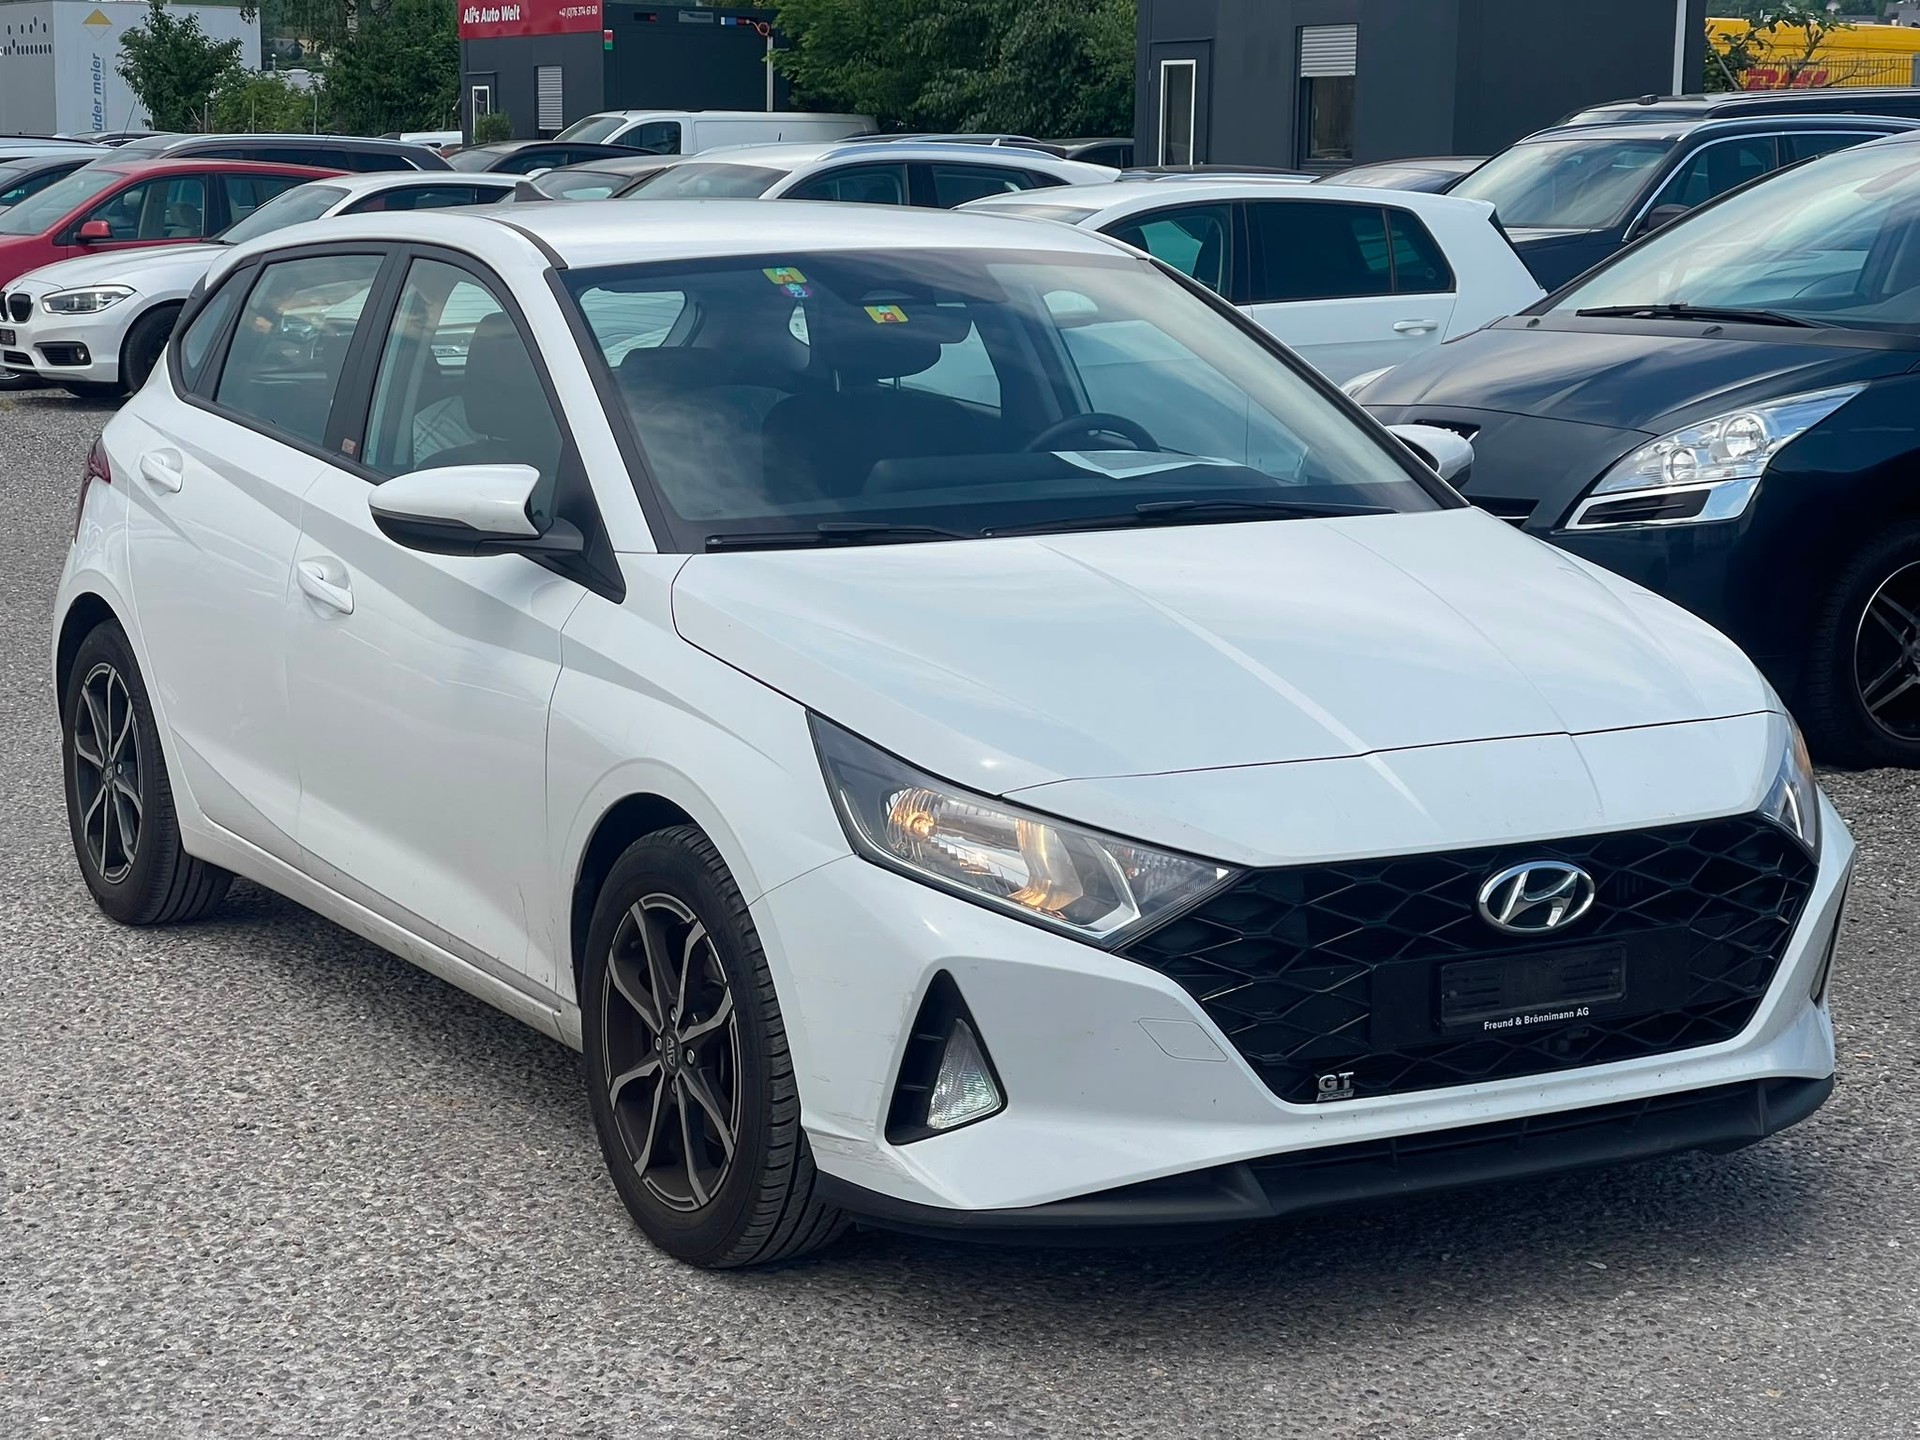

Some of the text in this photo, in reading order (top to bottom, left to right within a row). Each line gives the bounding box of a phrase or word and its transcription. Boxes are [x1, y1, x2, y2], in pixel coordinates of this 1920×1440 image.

[463, 4, 520, 24] Ali's Auto Welt
[90, 53, 102, 95] meier
[1484, 1006, 1590, 1031] Freund & Brönnimann AG
[1318, 1072, 1355, 1092] GT
